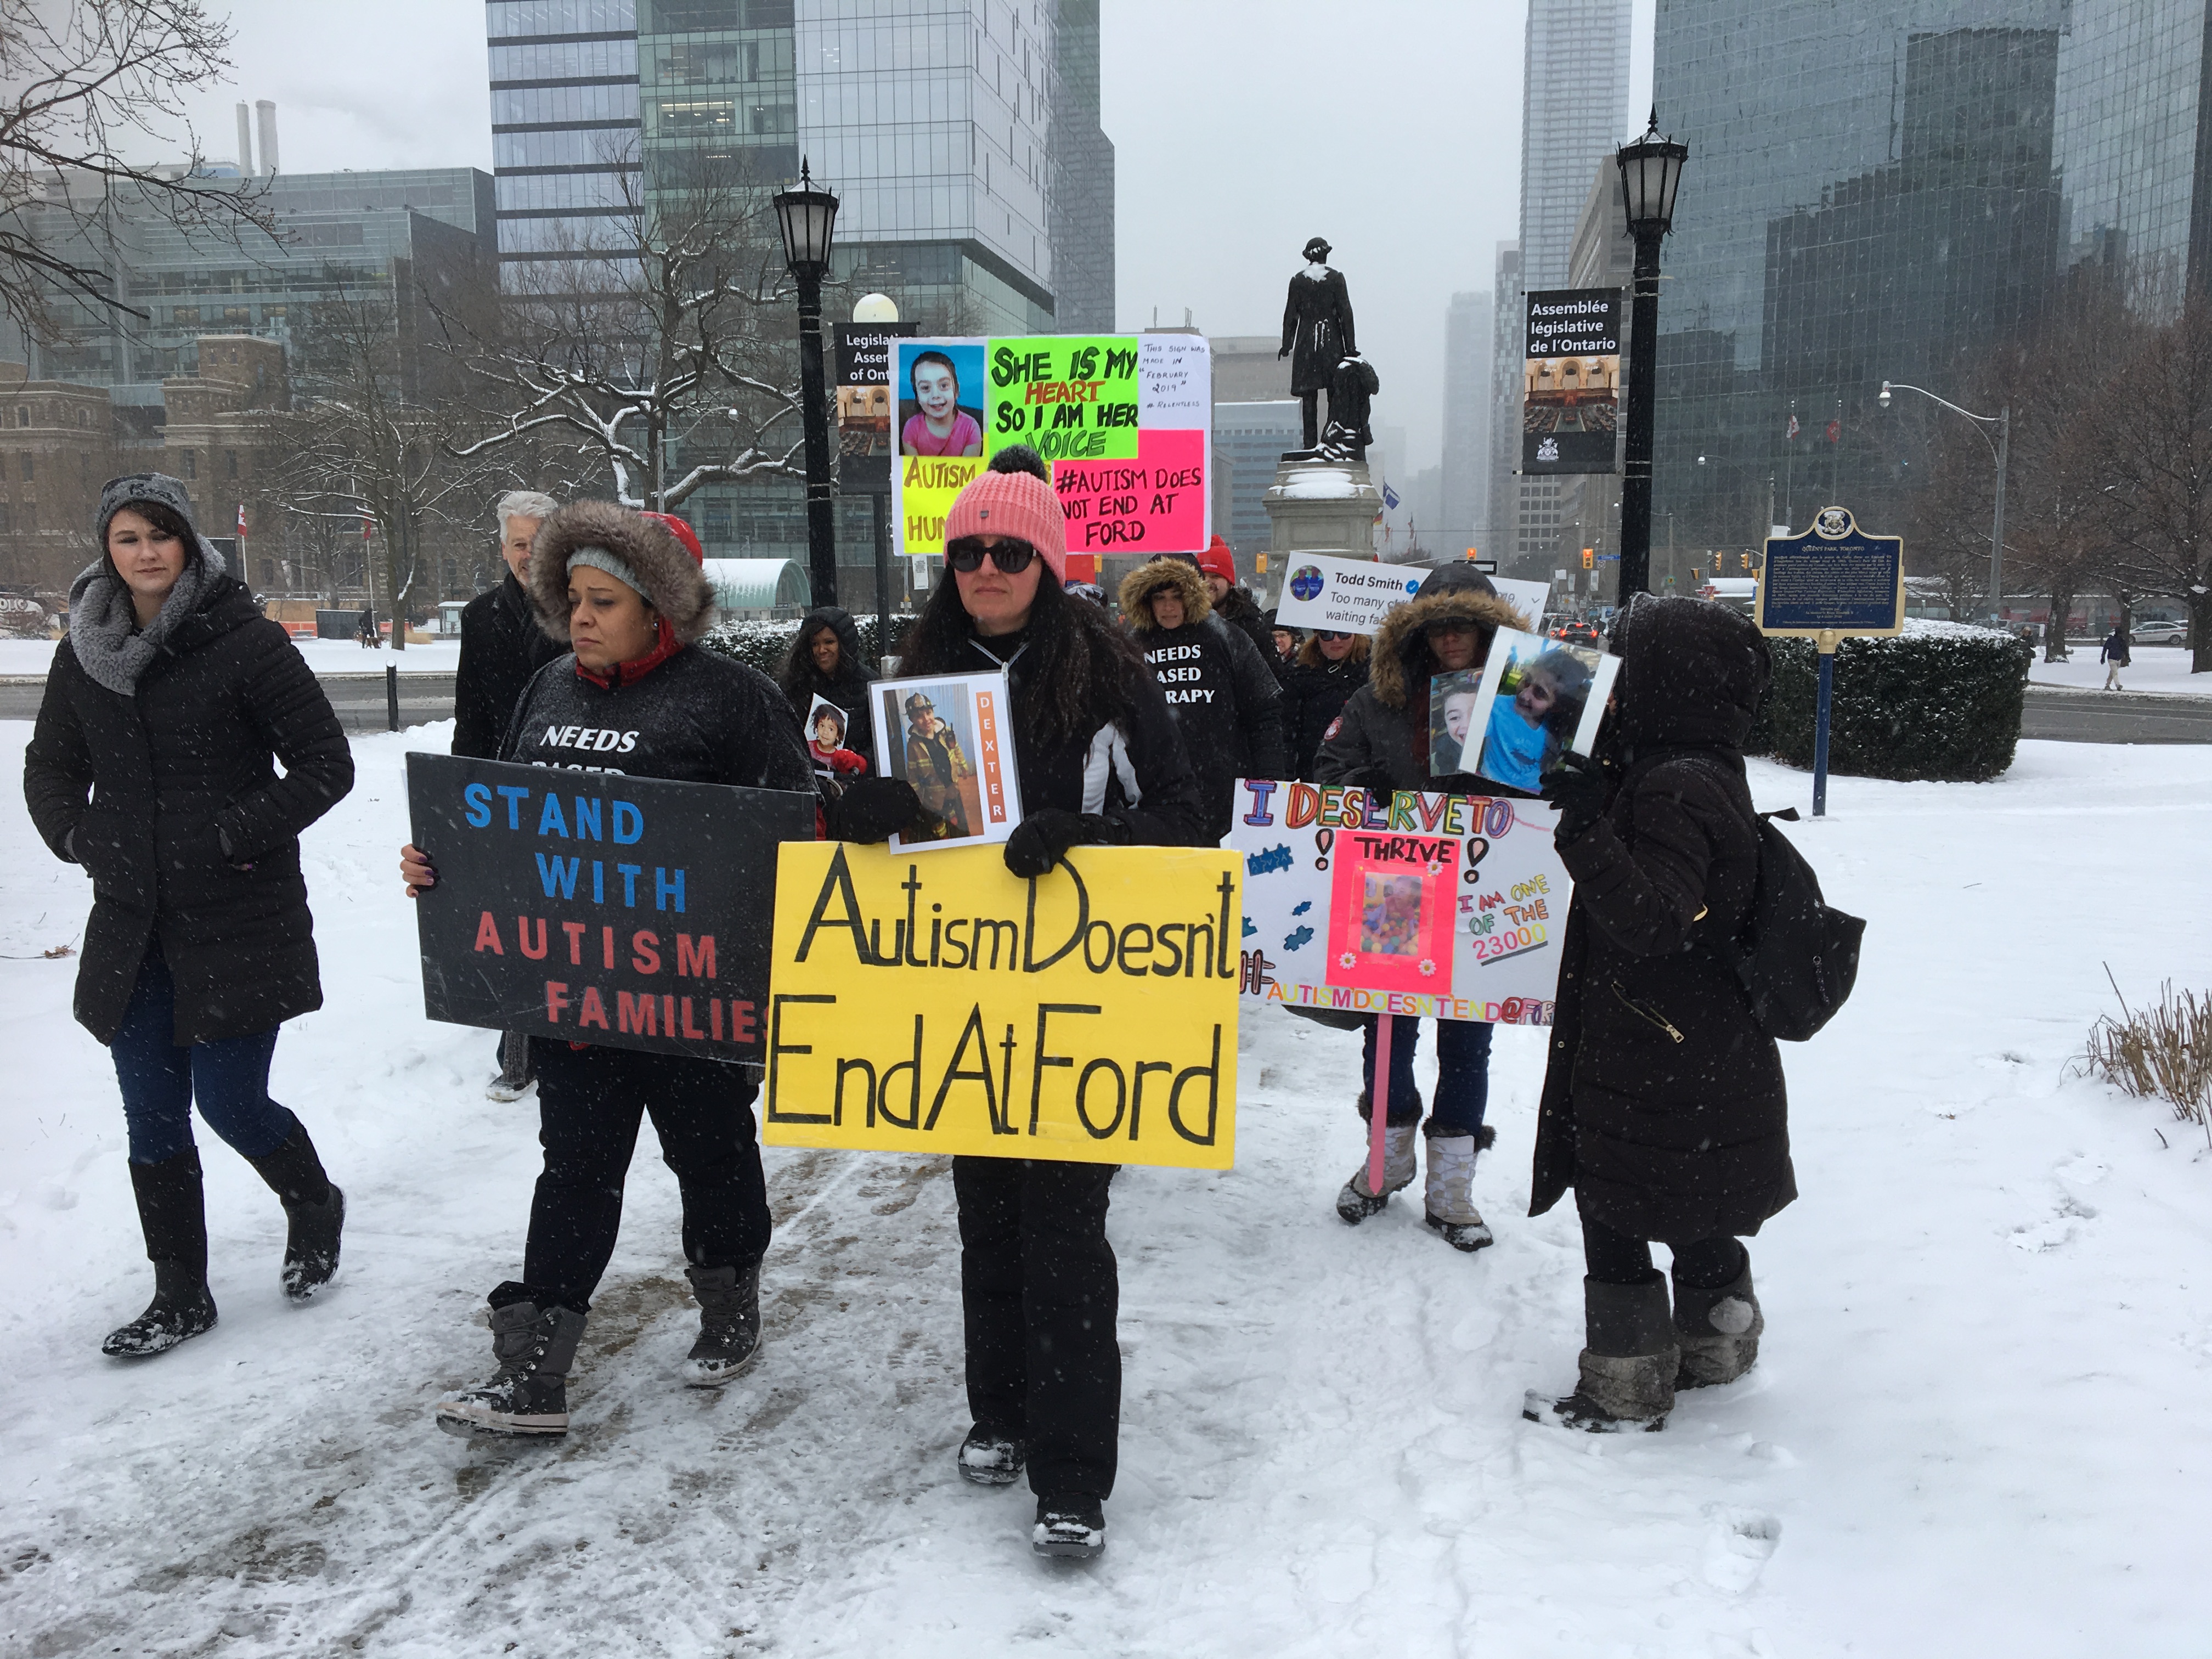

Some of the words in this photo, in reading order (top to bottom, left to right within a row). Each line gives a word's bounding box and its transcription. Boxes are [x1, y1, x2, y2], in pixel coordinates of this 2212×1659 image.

[1531, 300, 1609, 315] Assemblée
[1532, 320, 1604, 337] législative
[1144, 343, 1162, 352] THIS
[1531, 340, 1548, 353] de
[850, 369, 864, 380] of
[991, 347, 1052, 387] SHE
[1069, 348, 1097, 381] IS
[1106, 347, 1138, 380] MY
[1025, 380, 1106, 405] HEART
[996, 401, 1025, 433] SO
[1034, 402, 1043, 430] I
[1052, 402, 1084, 429] AM
[1097, 402, 1138, 428] HER
[1025, 430, 1107, 460] VOICE
[904, 456, 975, 489] AUTISM
[1056, 469, 1148, 494] #AUTISM
[1156, 467, 1202, 489] DOES
[1099, 495, 1138, 517] END
[1149, 493, 1179, 515] AT
[1086, 521, 1146, 547] FORD
[1335, 572, 1365, 585] Todd
[1368, 576, 1403, 591] Smith
[1331, 591, 1350, 603] Too
[1353, 596, 1384, 610] many
[1326, 610, 1366, 626] waiting
[1143, 644, 1201, 664] NEEDS
[1157, 667, 1201, 684] ASED
[539, 725, 640, 753] NEEDS
[980, 697, 1002, 816] DEXTER
[464, 782, 644, 845] STAND
[1244, 778, 1277, 827] I
[1353, 837, 1457, 864] THRIVE
[535, 852, 686, 913] WITH
[1459, 895, 1474, 913] I
[1479, 891, 1505, 912] AM
[1510, 874, 1550, 902] ONE
[1469, 913, 1495, 935] OF
[1503, 899, 1549, 926] THE
[475, 911, 716, 979] AUTISM
[1472, 924, 1547, 961] 23000
[546, 980, 769, 1043] FAMILIE
